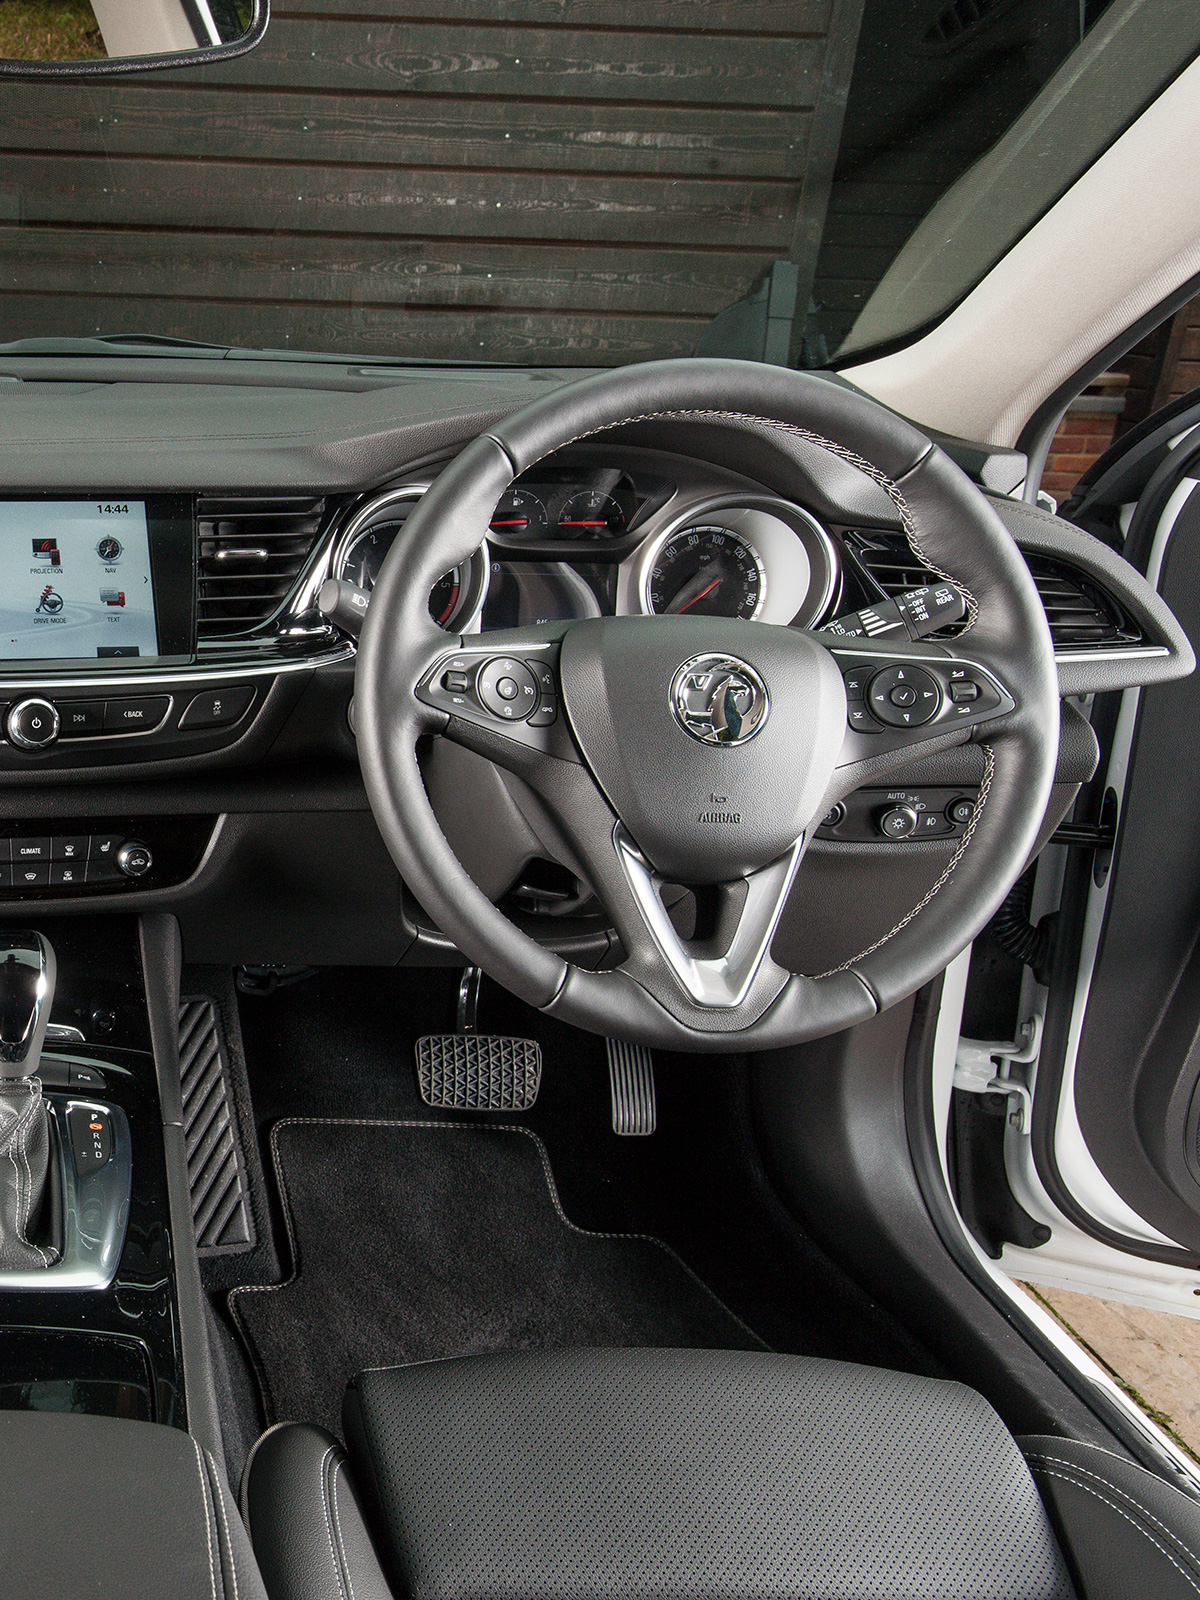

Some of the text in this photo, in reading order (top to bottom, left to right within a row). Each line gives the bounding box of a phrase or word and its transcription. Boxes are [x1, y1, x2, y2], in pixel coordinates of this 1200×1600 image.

[97, 504, 129, 514] 14:44
[369, 534, 378, 545] 2
[687, 534, 699, 546] 80
[712, 534, 725, 546] 100
[664, 545, 678, 558] 60
[733, 545, 747, 560] 120
[746, 568, 758, 581] 140
[745, 592, 757, 606] 160
[911, 598, 924, 608] OFF
[935, 593, 954, 606] REAR
[915, 604, 926, 613] INT
[918, 612, 929, 621] ON
[127, 710, 143, 718] BACK
[699, 812, 741, 823] AIRBAG
[91, 1113, 98, 1121] P
[94, 1141, 102, 1149] N
[95, 1151, 103, 1159] D
